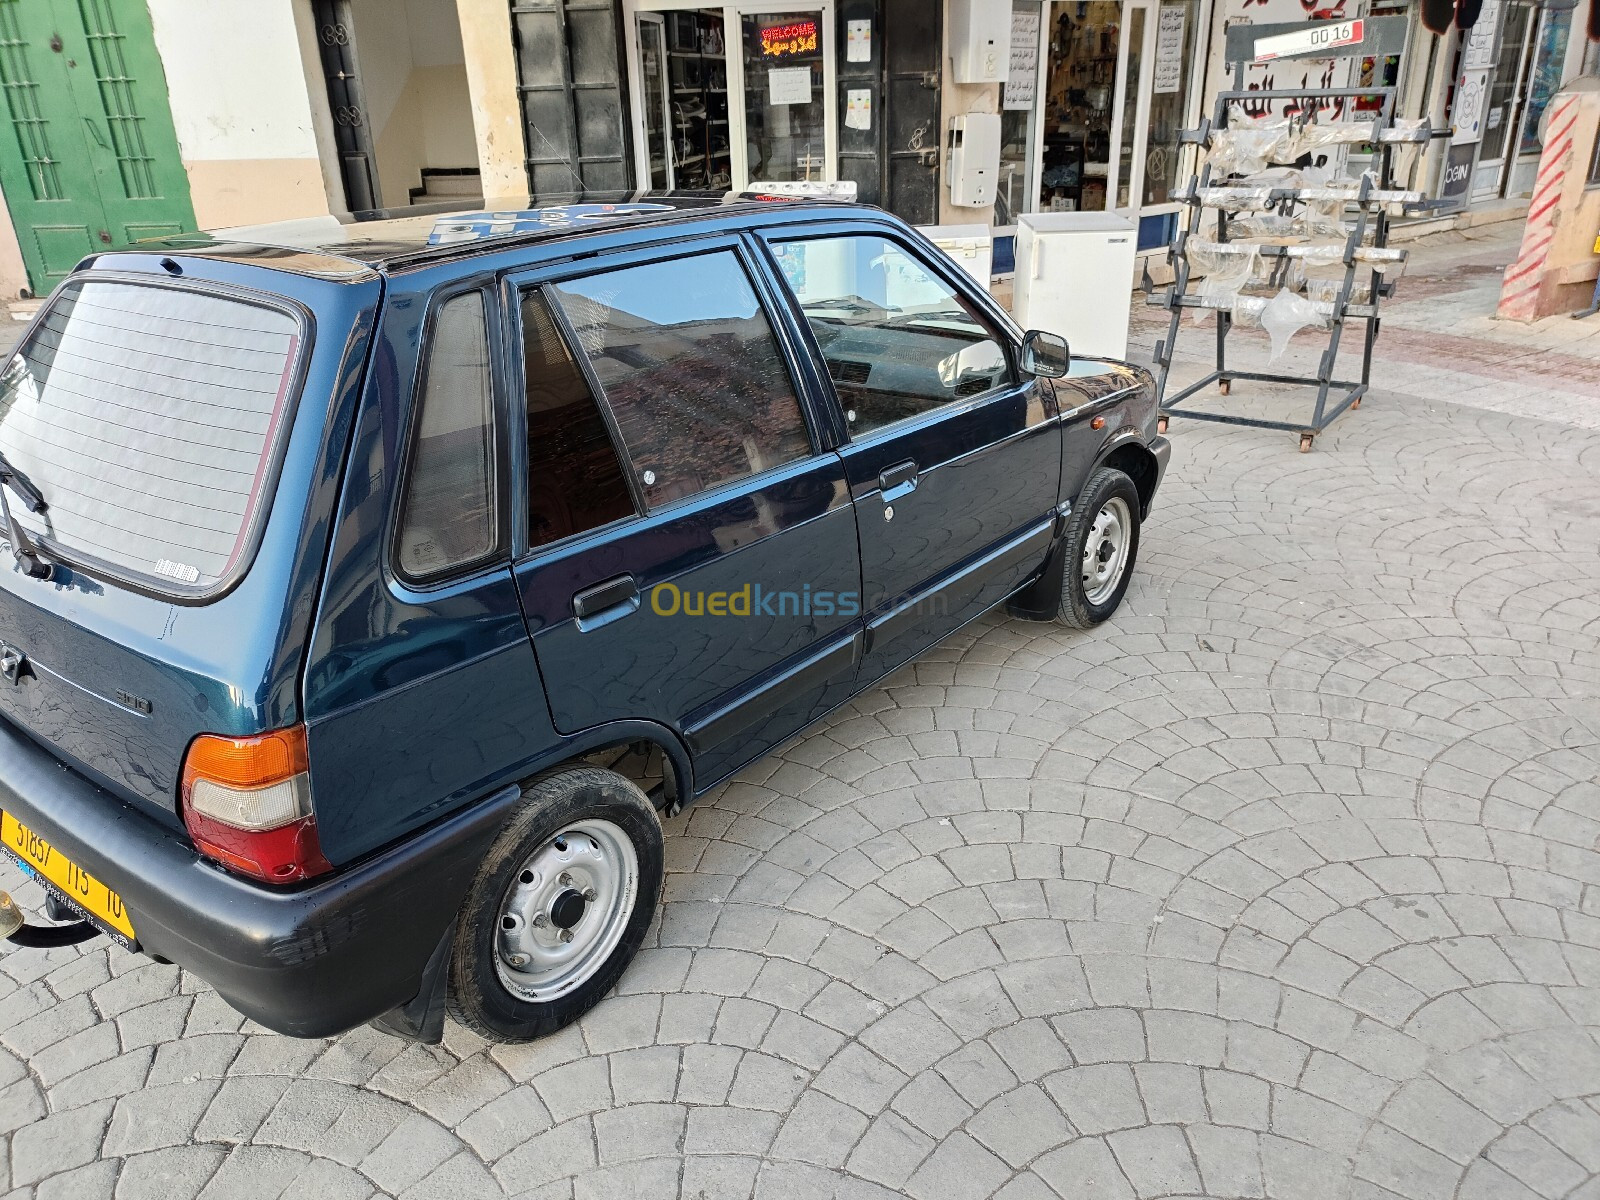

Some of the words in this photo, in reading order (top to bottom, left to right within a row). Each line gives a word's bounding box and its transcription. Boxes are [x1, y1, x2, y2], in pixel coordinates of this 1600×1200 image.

[761, 21, 816, 40] WELCOME
[1333, 25, 1350, 41] 16
[107, 889, 122, 919] 10
